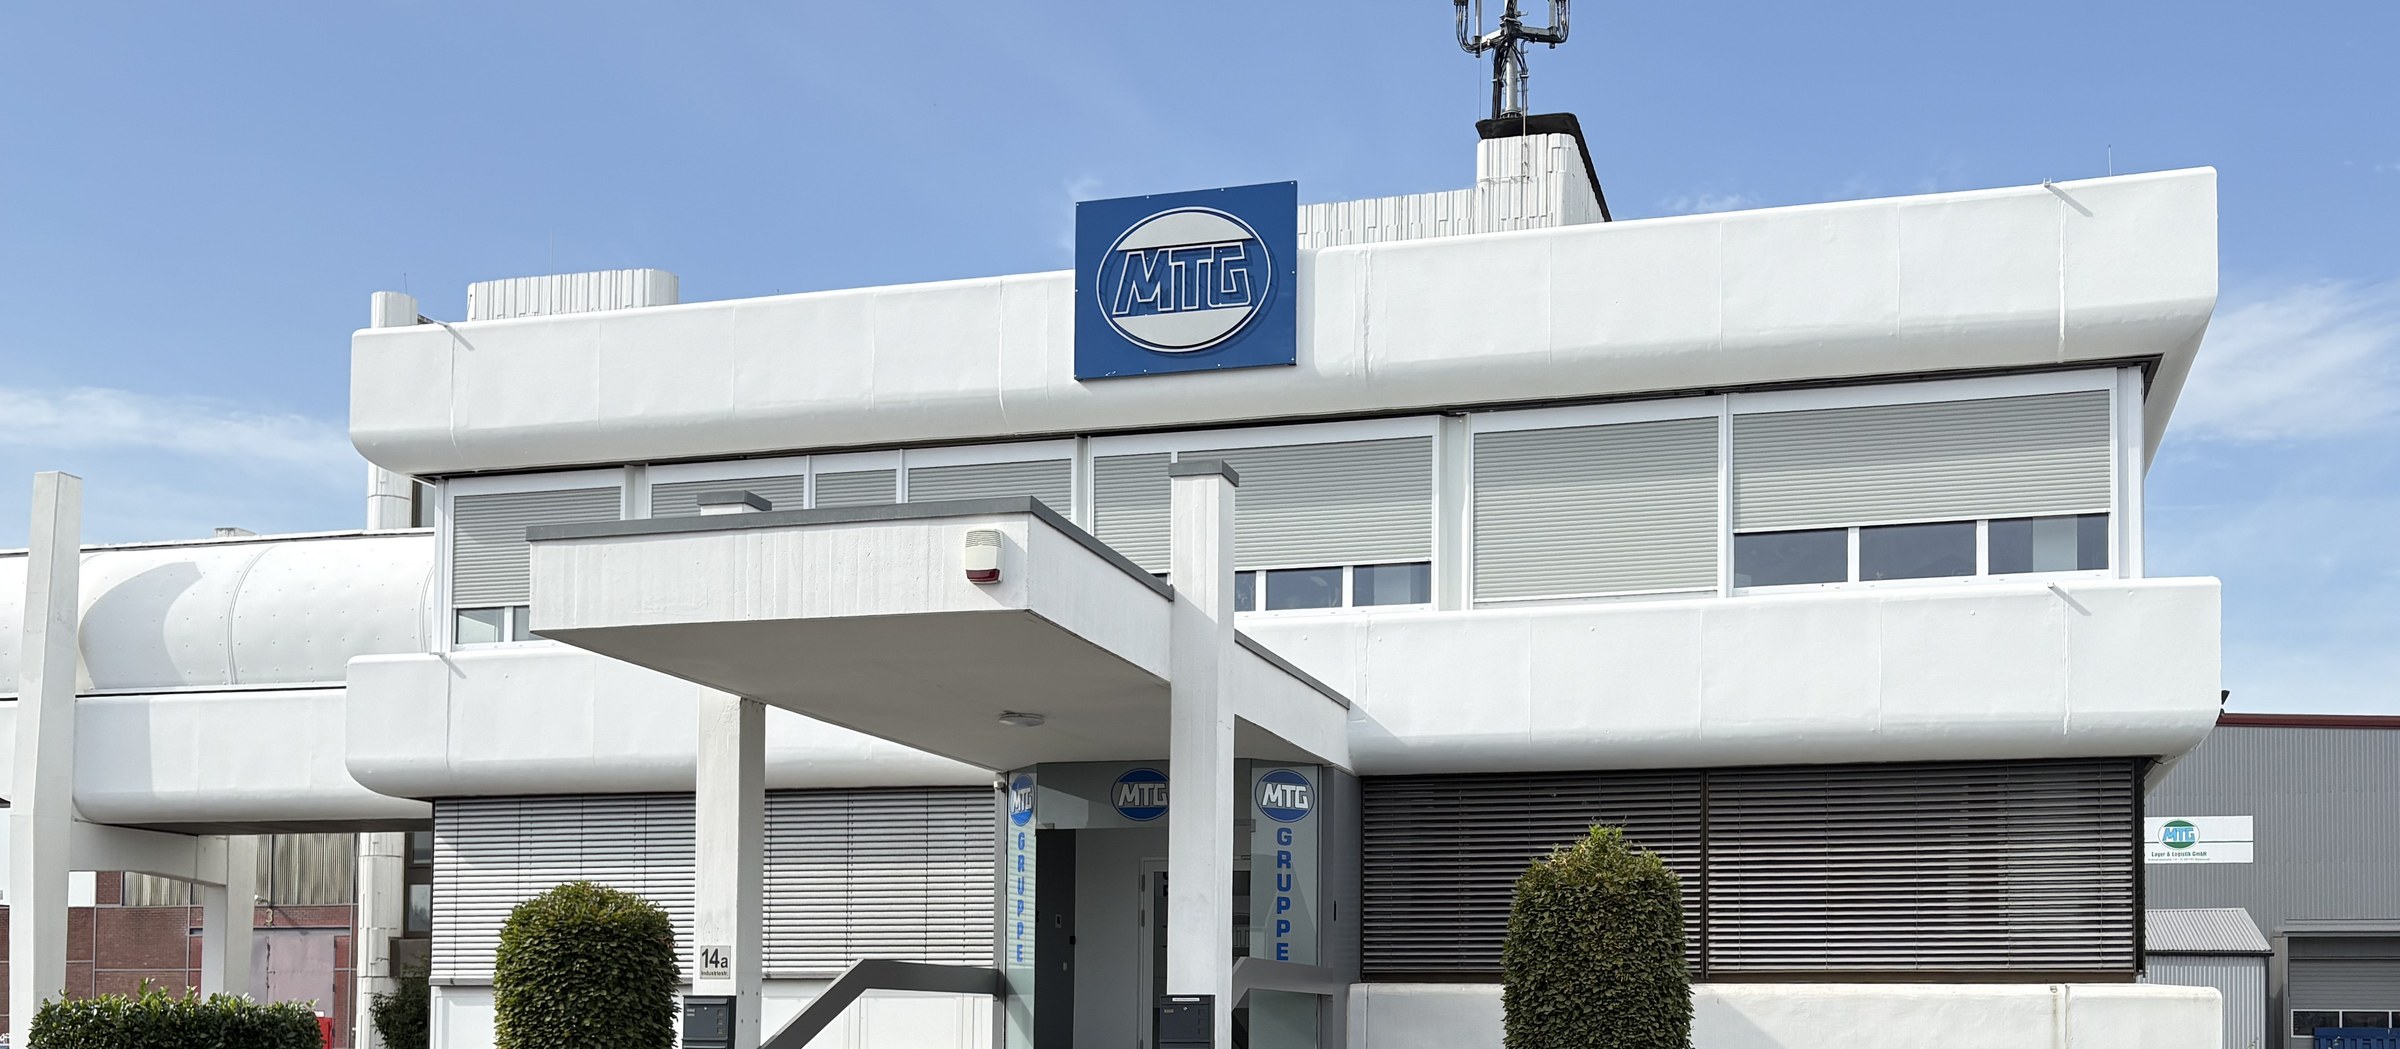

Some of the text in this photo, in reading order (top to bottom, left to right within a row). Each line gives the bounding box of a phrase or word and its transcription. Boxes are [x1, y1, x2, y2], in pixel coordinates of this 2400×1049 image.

[1112, 241, 1252, 316] MTG
[1011, 787, 1033, 813] MTG
[1118, 783, 1168, 807] MTG
[1262, 783, 1309, 809] MTG
[2162, 828, 2196, 842] MTG
[1016, 832, 1026, 962] GRUPPE
[1276, 827, 1292, 961] GRUPPE
[702, 948, 728, 968] 14a
